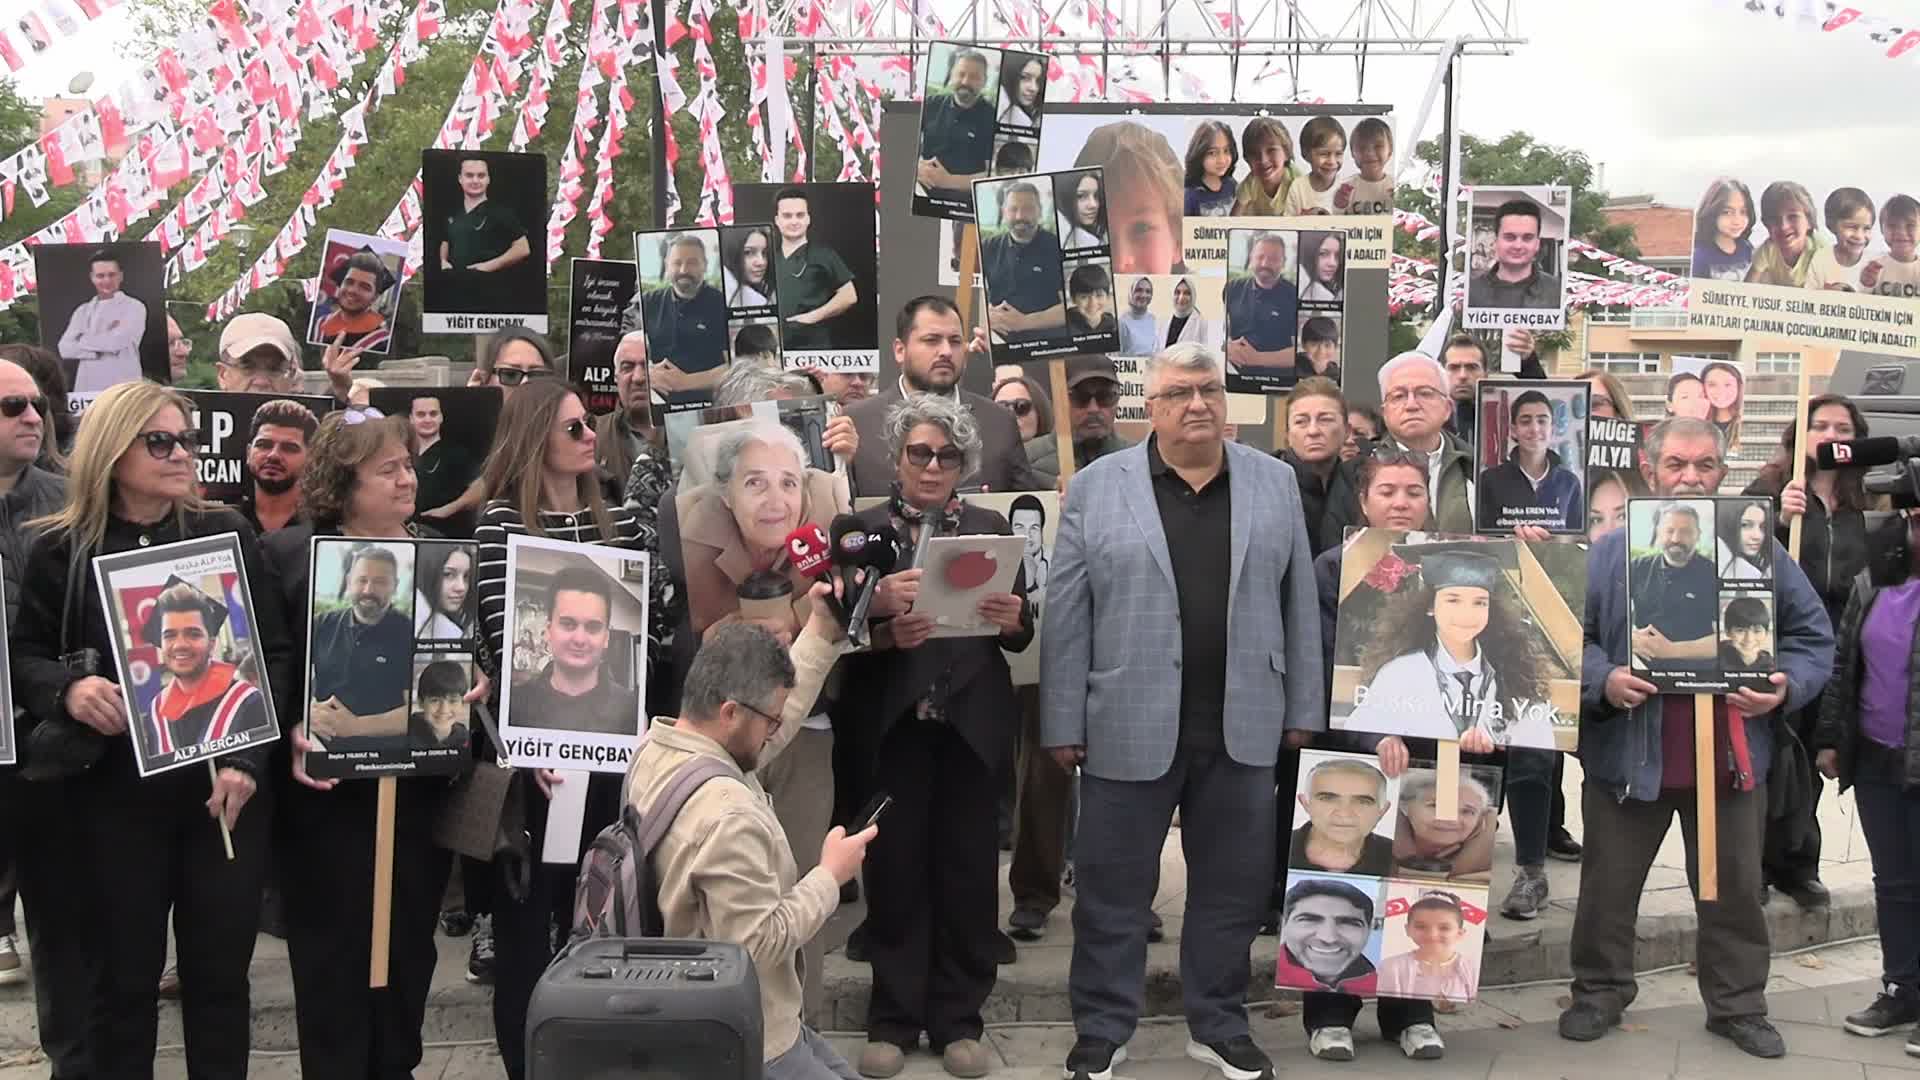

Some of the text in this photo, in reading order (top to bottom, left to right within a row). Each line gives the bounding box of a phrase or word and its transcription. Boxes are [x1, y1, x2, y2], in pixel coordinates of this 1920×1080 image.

[1185, 249, 1227, 260] HAYATLAR
[1467, 310, 1560, 326] YİĞİT GENÇBAY
[1702, 290, 1749, 309] SÜMEYYE,
[1752, 297, 1783, 312] YUSUF,
[1820, 303, 1846, 318] BEKİR
[1848, 306, 1891, 324] GÜLTEKİN
[1893, 310, 1913, 326] İÇİN
[1690, 312, 1917, 349] HAYATLARI ÇALINAN ÇOCUKLARIMIZ İÇİN ADALET!
[583, 367, 611, 382] ALP
[1589, 419, 1636, 443] MÜGE
[1588, 445, 1632, 469] ALYA
[173, 730, 251, 763] ALP MERCAN
[505, 737, 632, 766] YİĞİT GENÇBA
